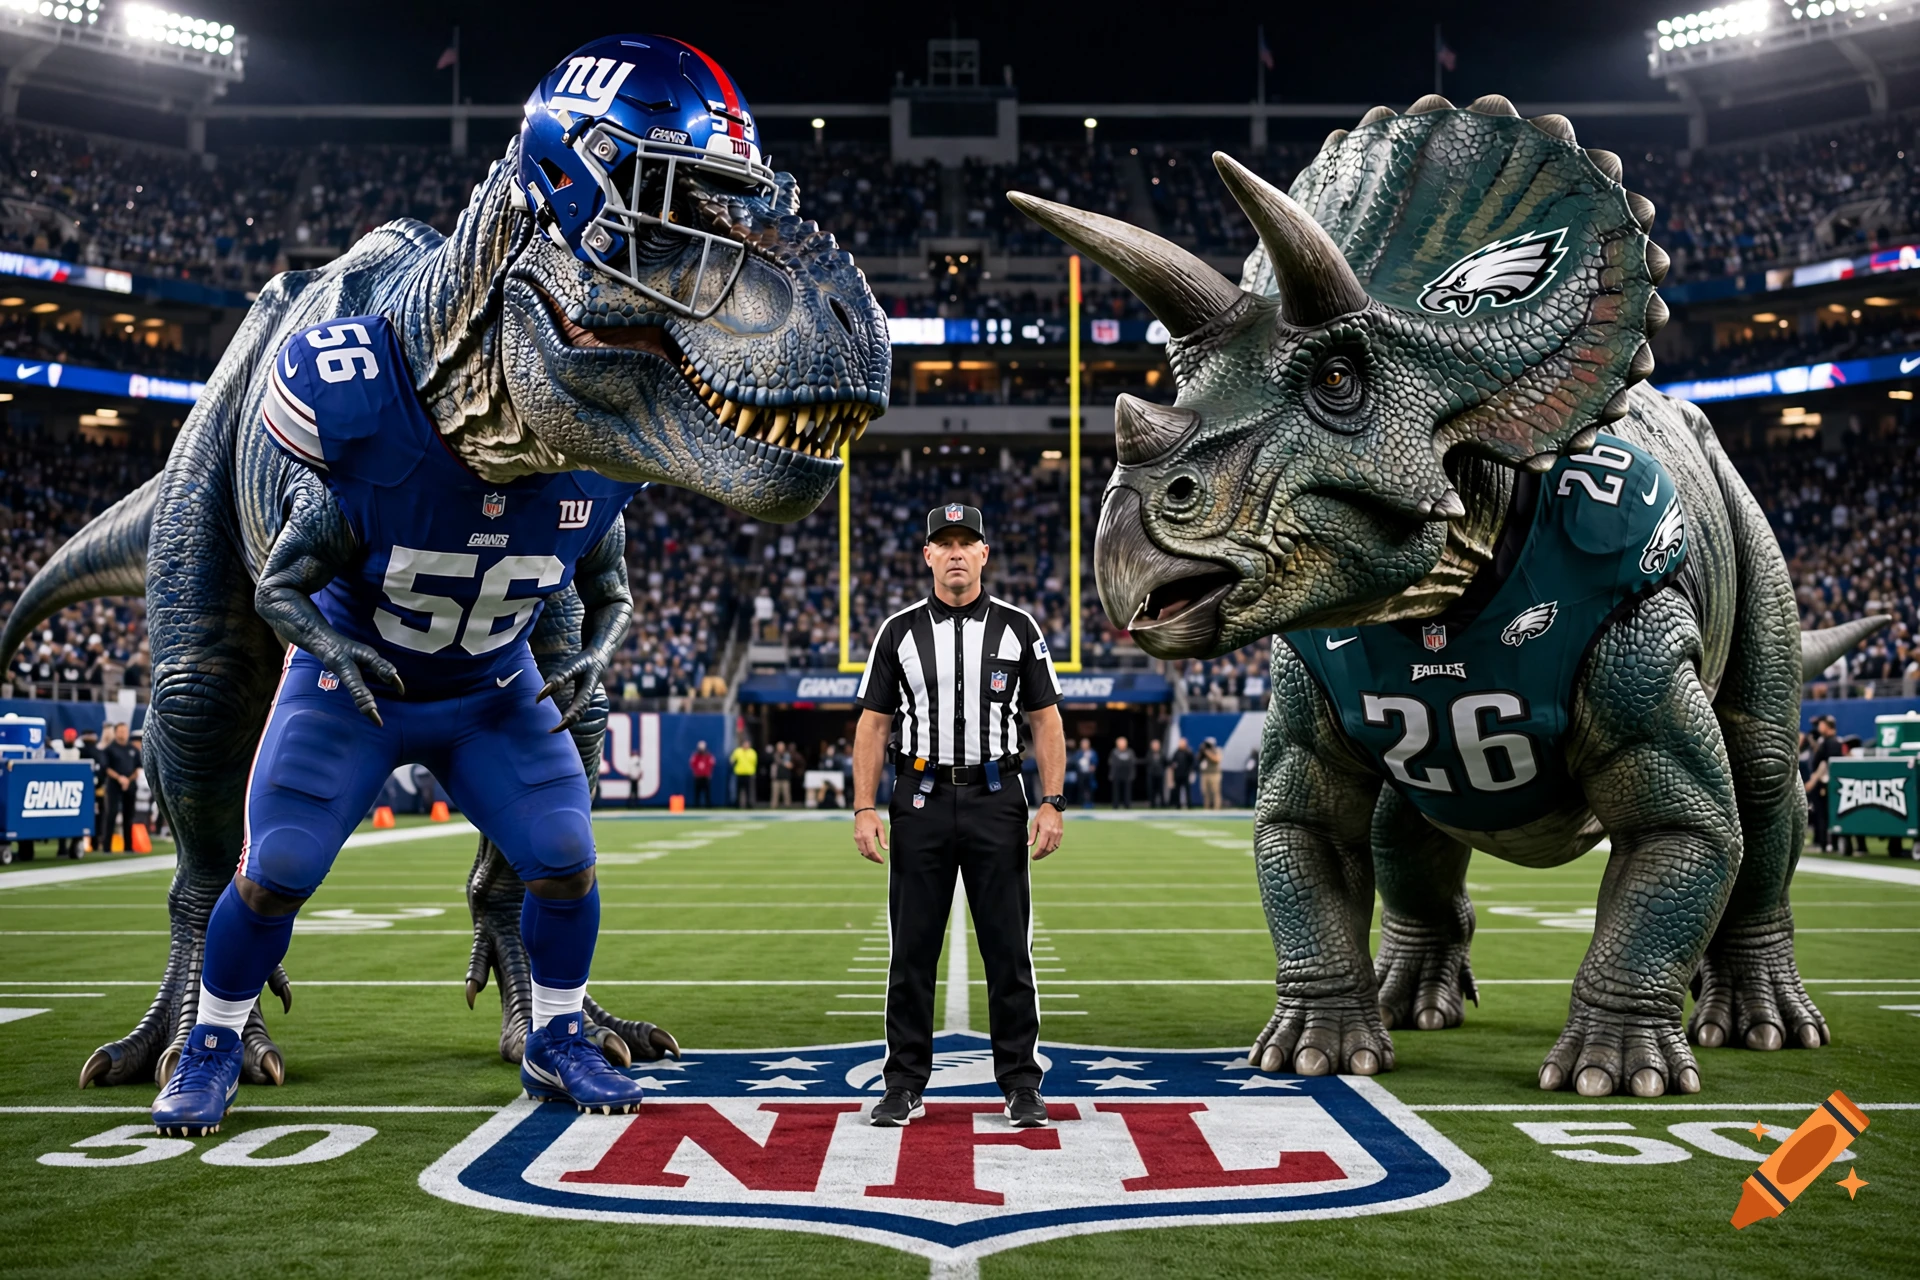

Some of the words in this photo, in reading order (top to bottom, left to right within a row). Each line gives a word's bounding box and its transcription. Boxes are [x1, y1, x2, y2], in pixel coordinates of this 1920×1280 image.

[305, 323, 379, 384] 56
[1557, 445, 1632, 505] 26
[467, 533, 509, 547] GIANTS
[373, 545, 566, 656] 56
[797, 678, 859, 697] GIANTS
[1410, 662, 1467, 681] EAGLES
[1361, 692, 1539, 793] 26
[23, 781, 84, 812] GIANTS
[1837, 777, 1908, 817] EAGLES
[36, 1124, 378, 1168] 50
[559, 1102, 1348, 1205] NFL
